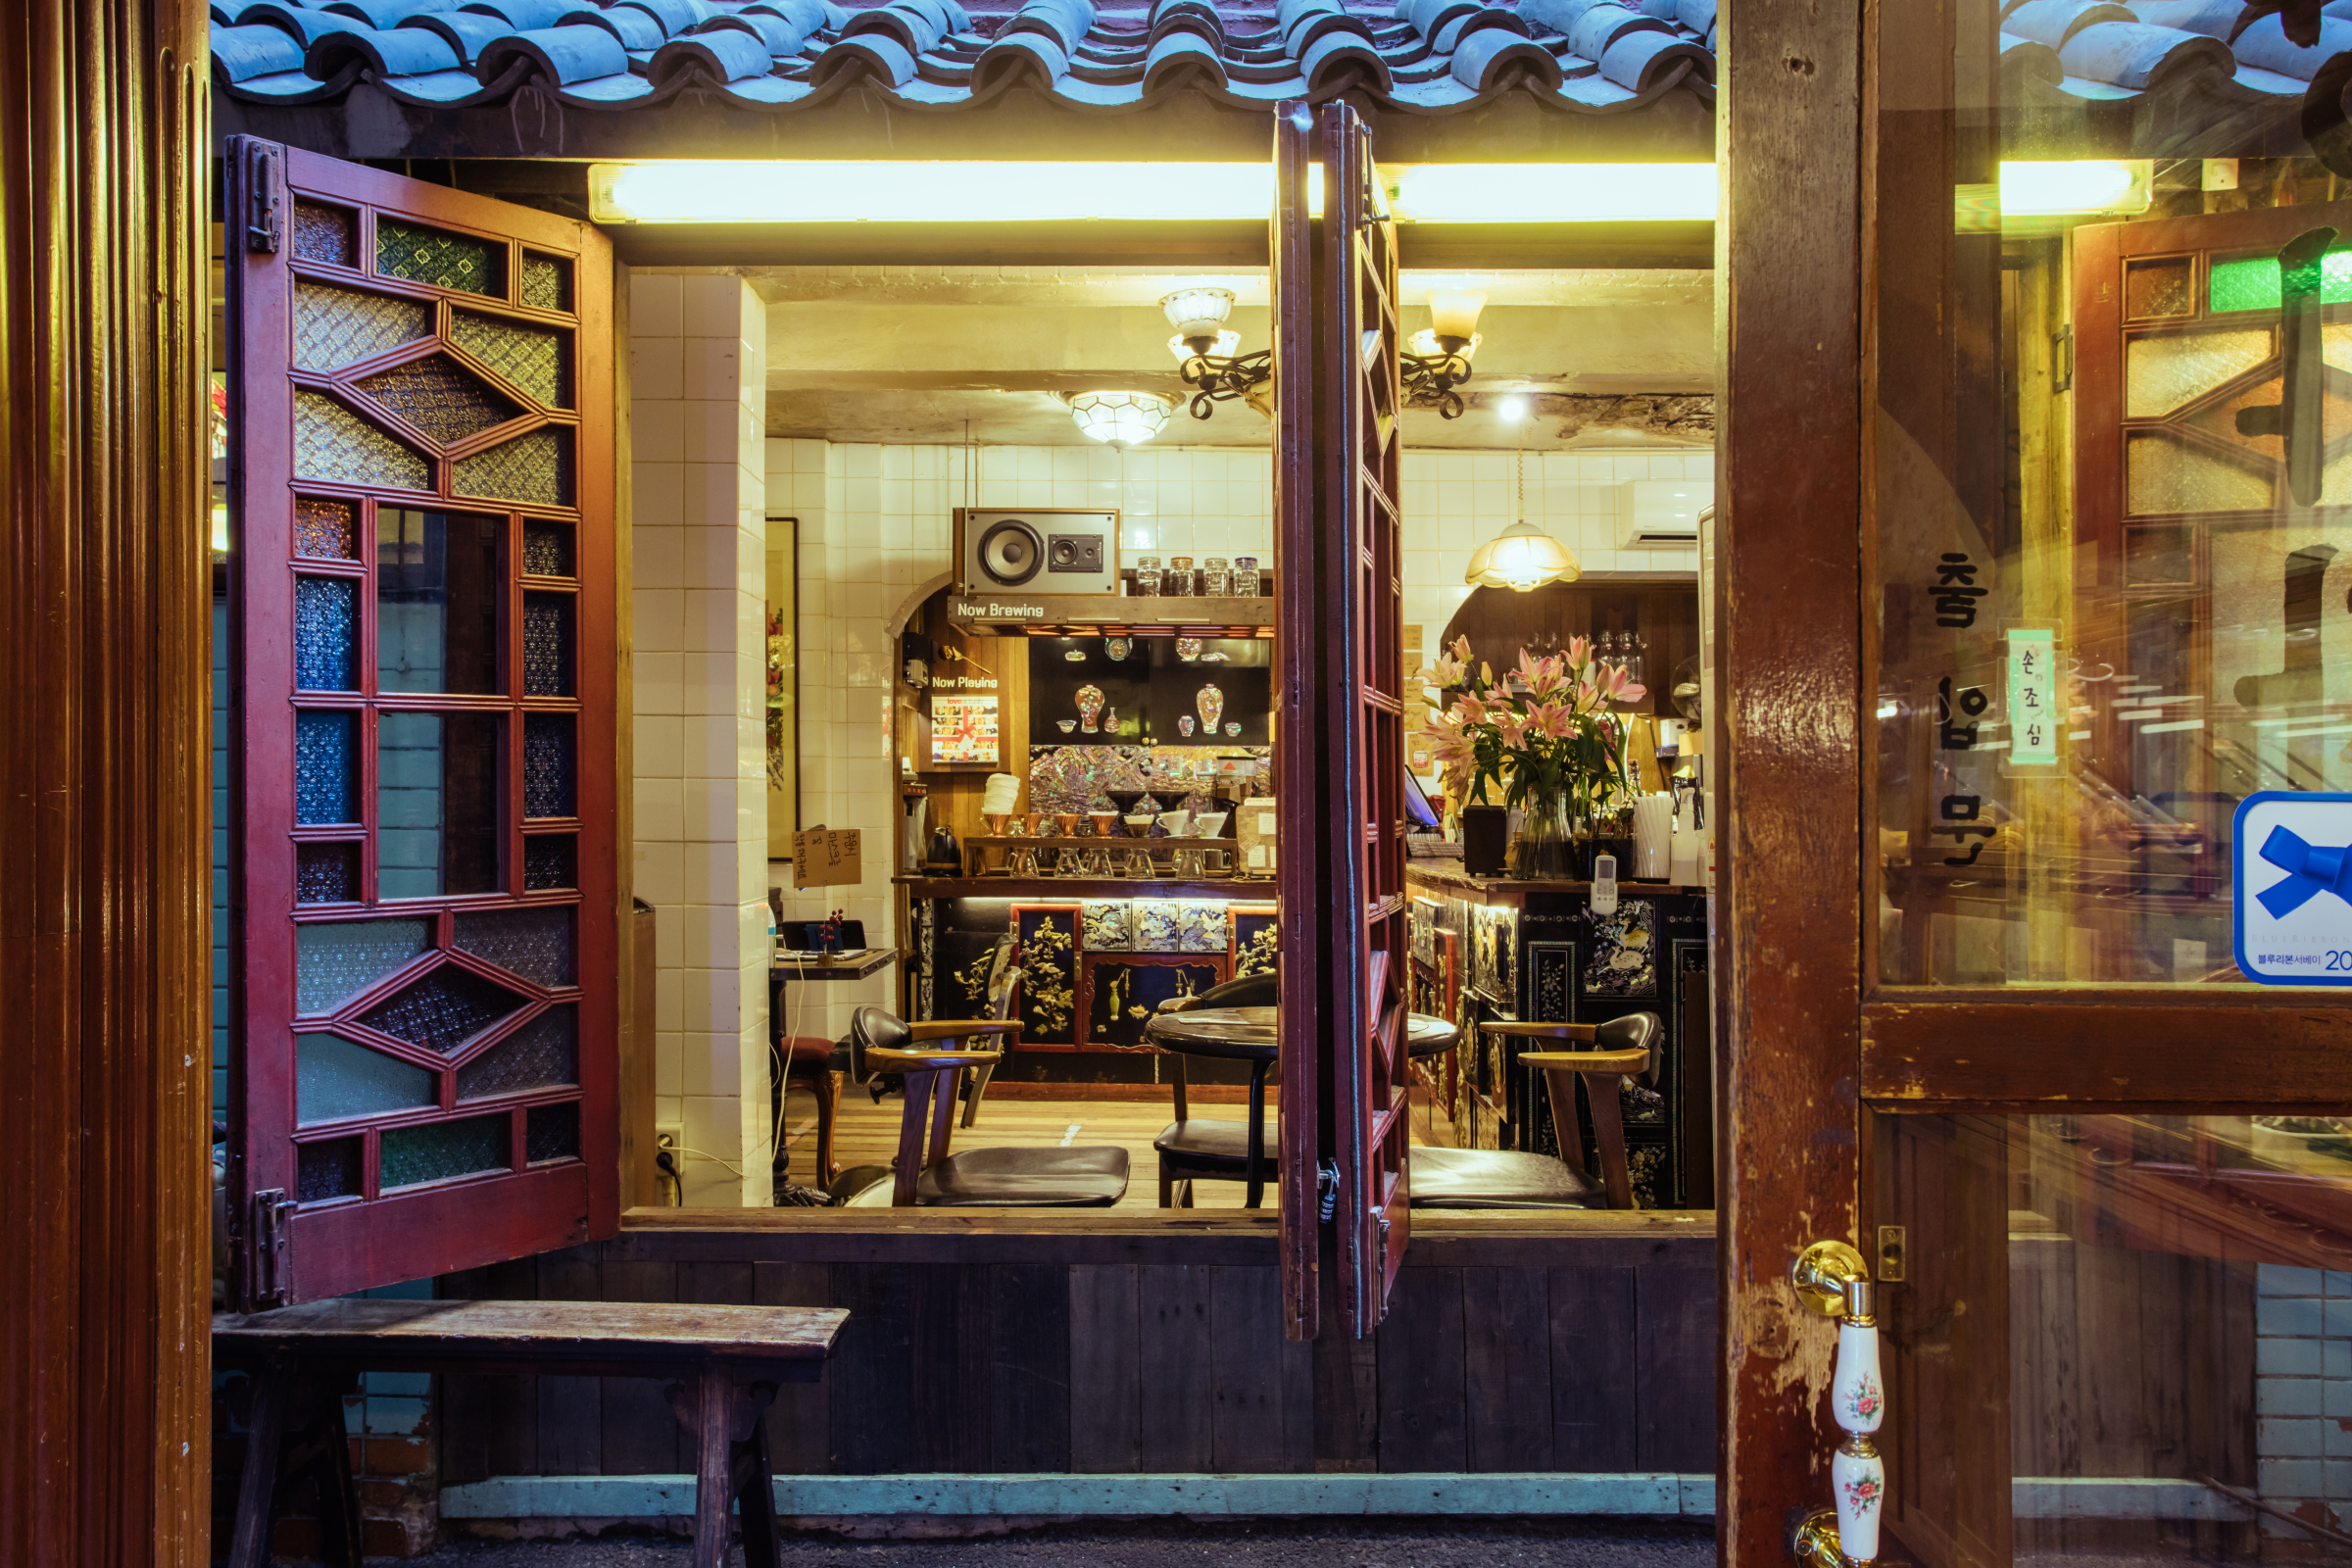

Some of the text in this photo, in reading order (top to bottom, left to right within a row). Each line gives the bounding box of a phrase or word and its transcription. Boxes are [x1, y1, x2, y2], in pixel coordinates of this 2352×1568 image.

[957, 603, 1044, 617] Now Brewing
[932, 676, 998, 688] Now Playing
[828, 832, 841, 866] 마스크를
[2258, 955, 2321, 964] 블루리본서베이
